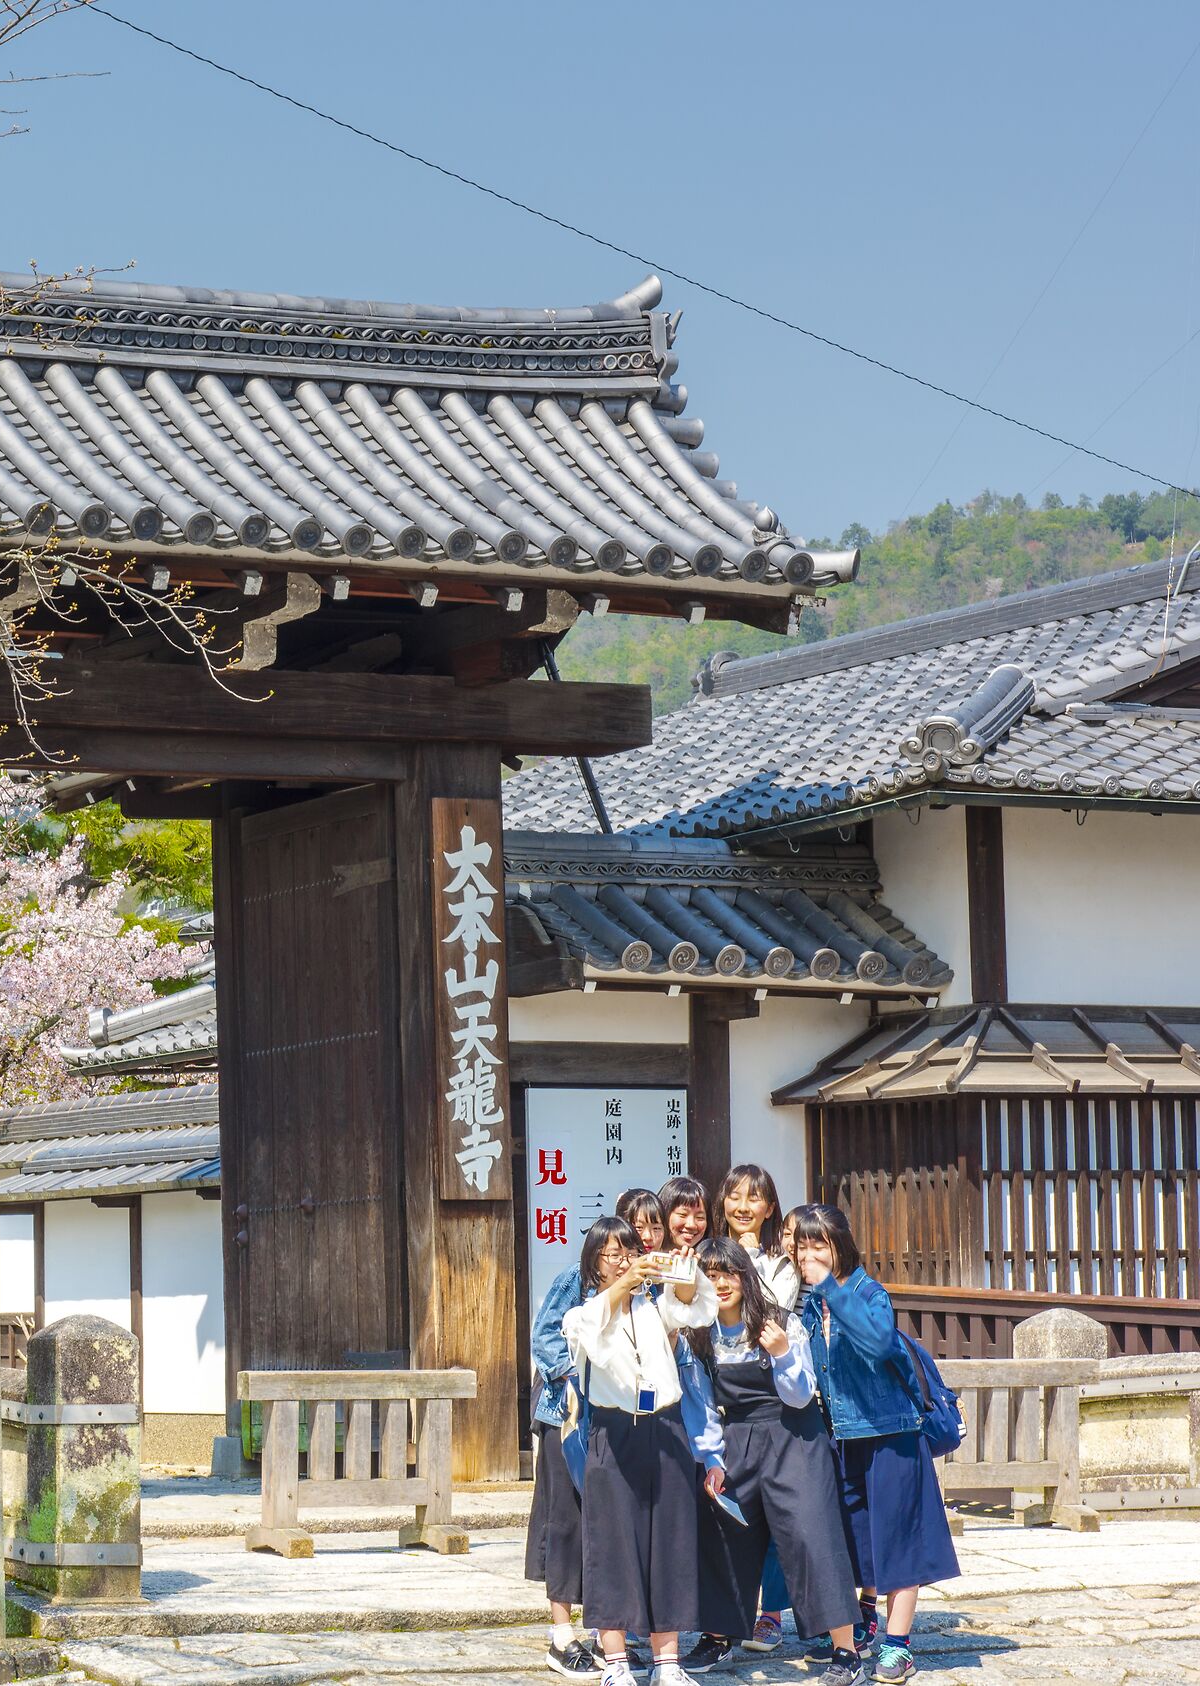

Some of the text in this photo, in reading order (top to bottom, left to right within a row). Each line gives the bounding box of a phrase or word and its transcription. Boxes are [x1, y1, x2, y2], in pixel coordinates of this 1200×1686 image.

[442, 824, 504, 1193] 大本山天龍寺
[605, 1099, 623, 1165] 庭園内
[666, 1099, 682, 1176] 史跡・特別
[535, 1149, 567, 1245] 見頃
